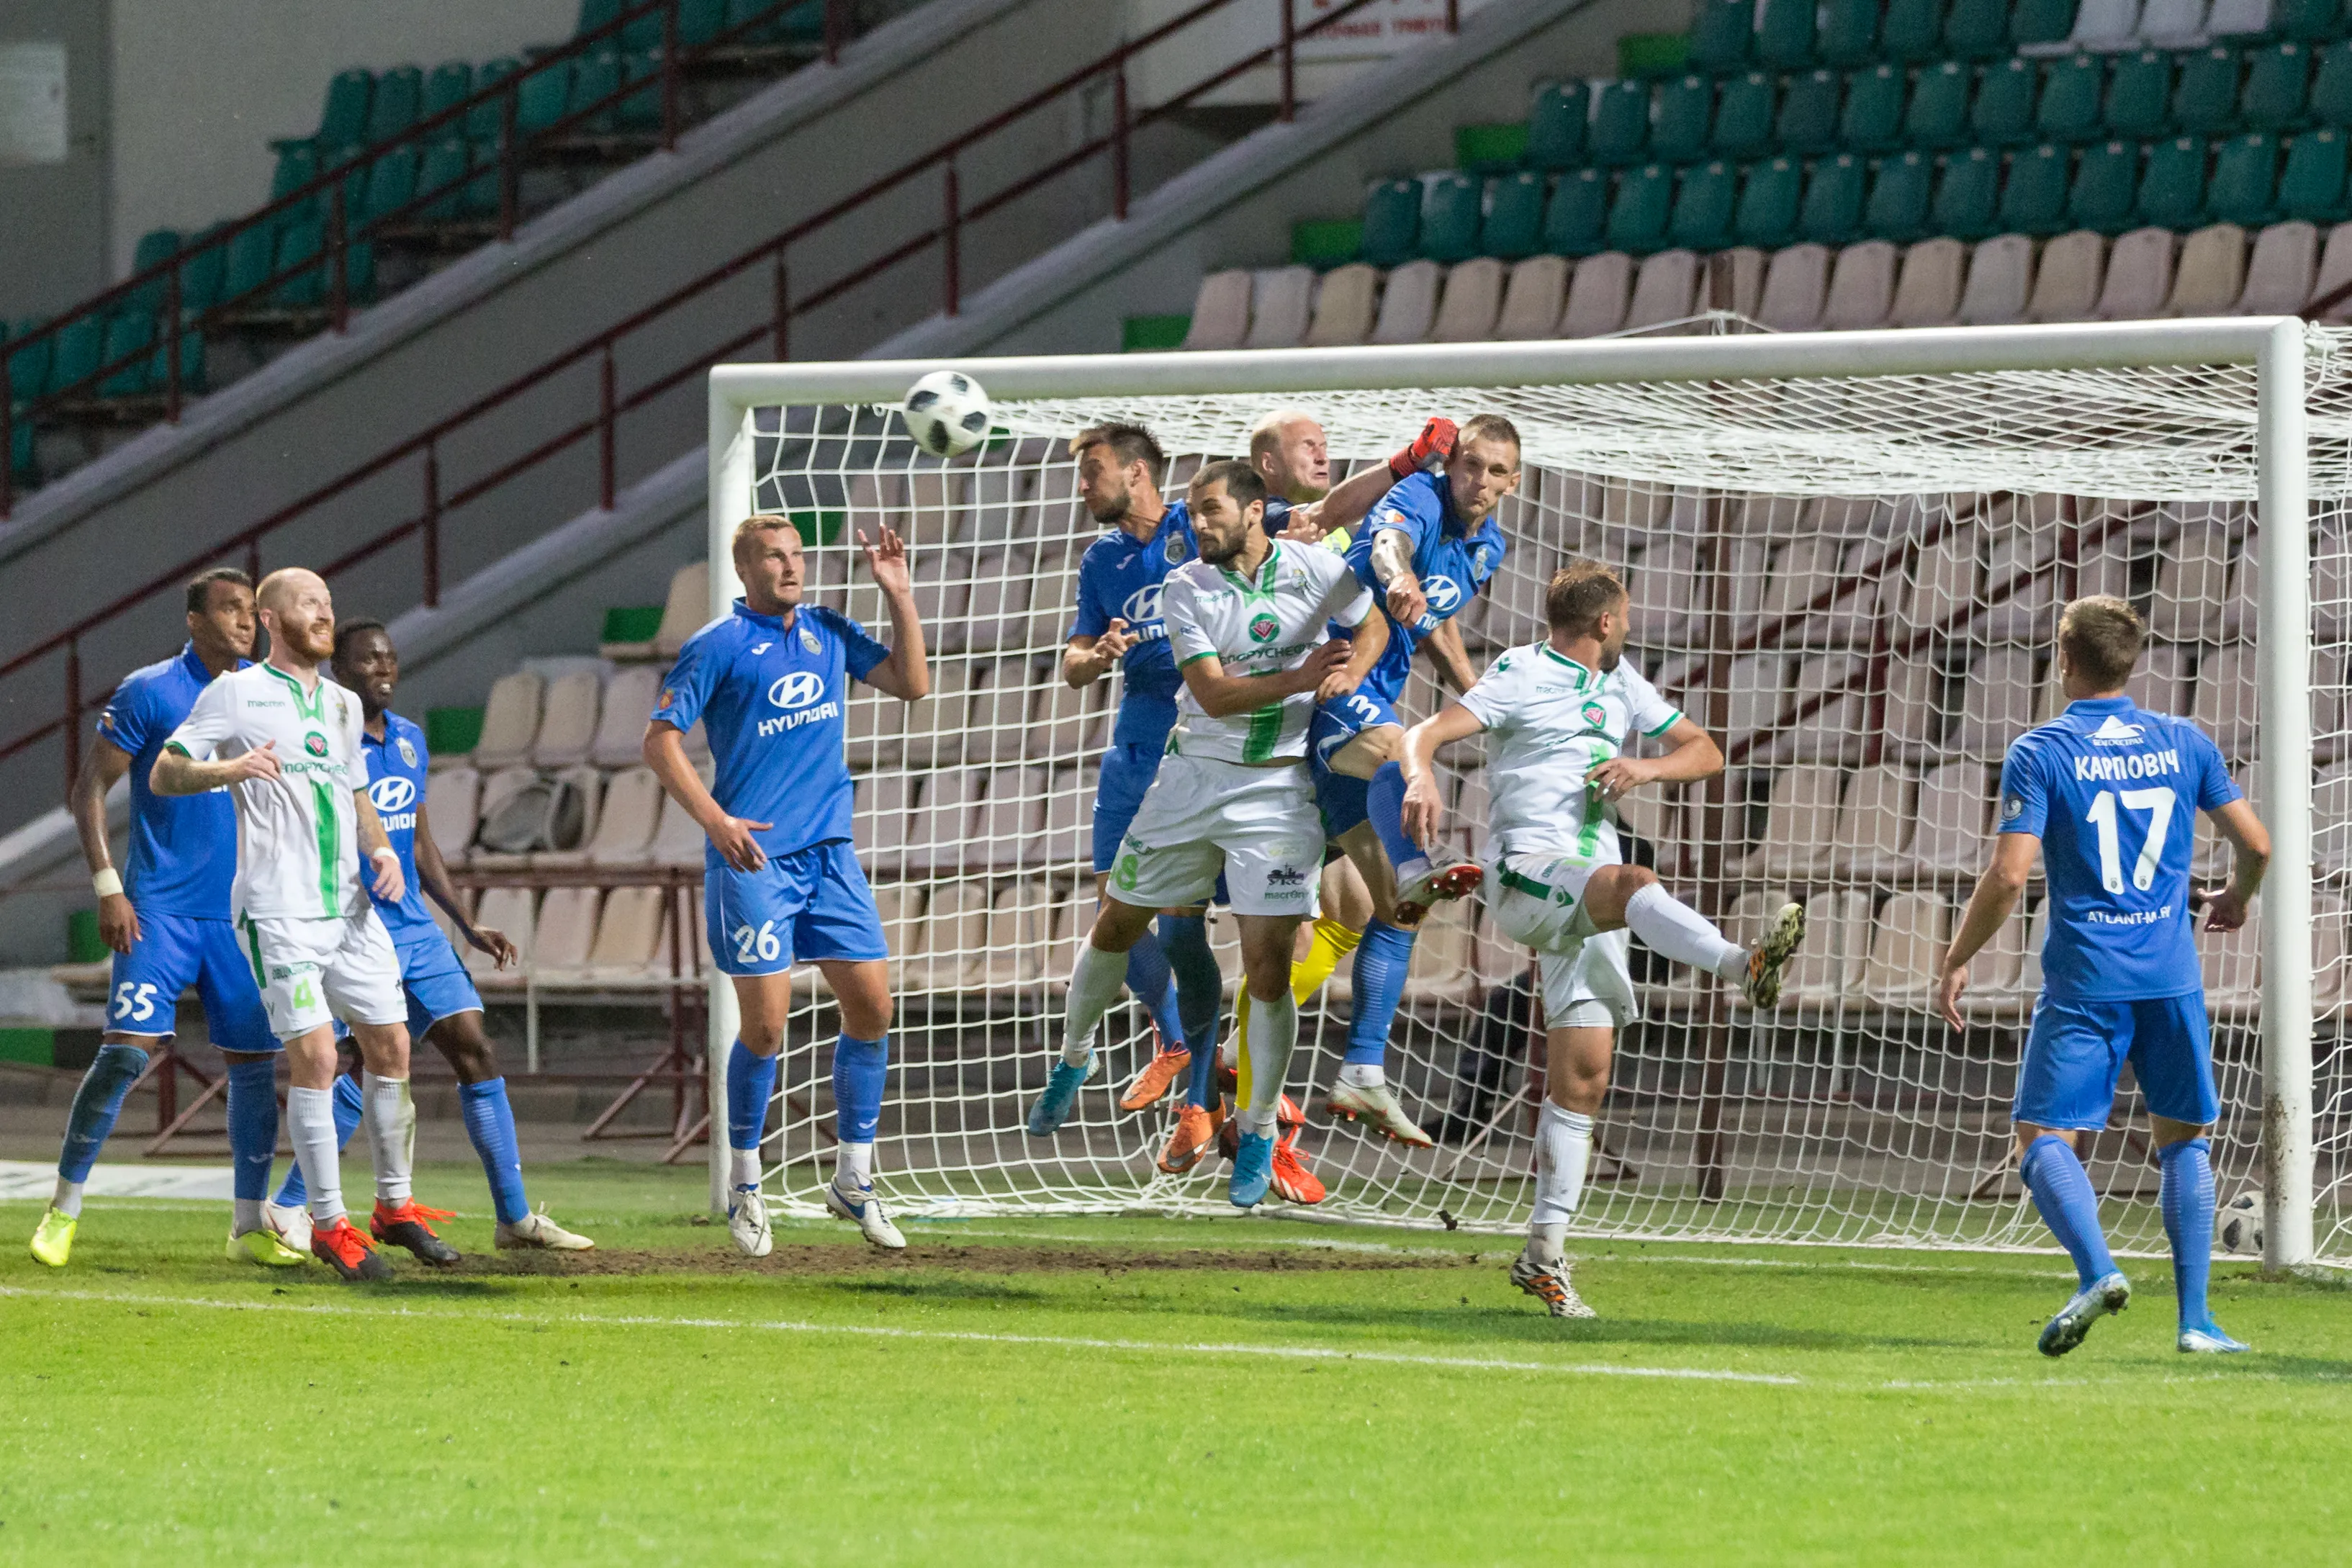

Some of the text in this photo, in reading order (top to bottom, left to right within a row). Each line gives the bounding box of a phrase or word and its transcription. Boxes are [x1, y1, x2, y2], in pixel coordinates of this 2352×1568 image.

[757, 701, 839, 737] HYUNDAI
[1347, 695, 1381, 723] 3
[2074, 749, 2180, 782] КАРПОВІЧ
[2086, 787, 2176, 896] 17
[1264, 891, 1307, 900] macron
[734, 919, 781, 964] 26
[114, 981, 158, 1022] 55
[293, 976, 316, 1015] 4
